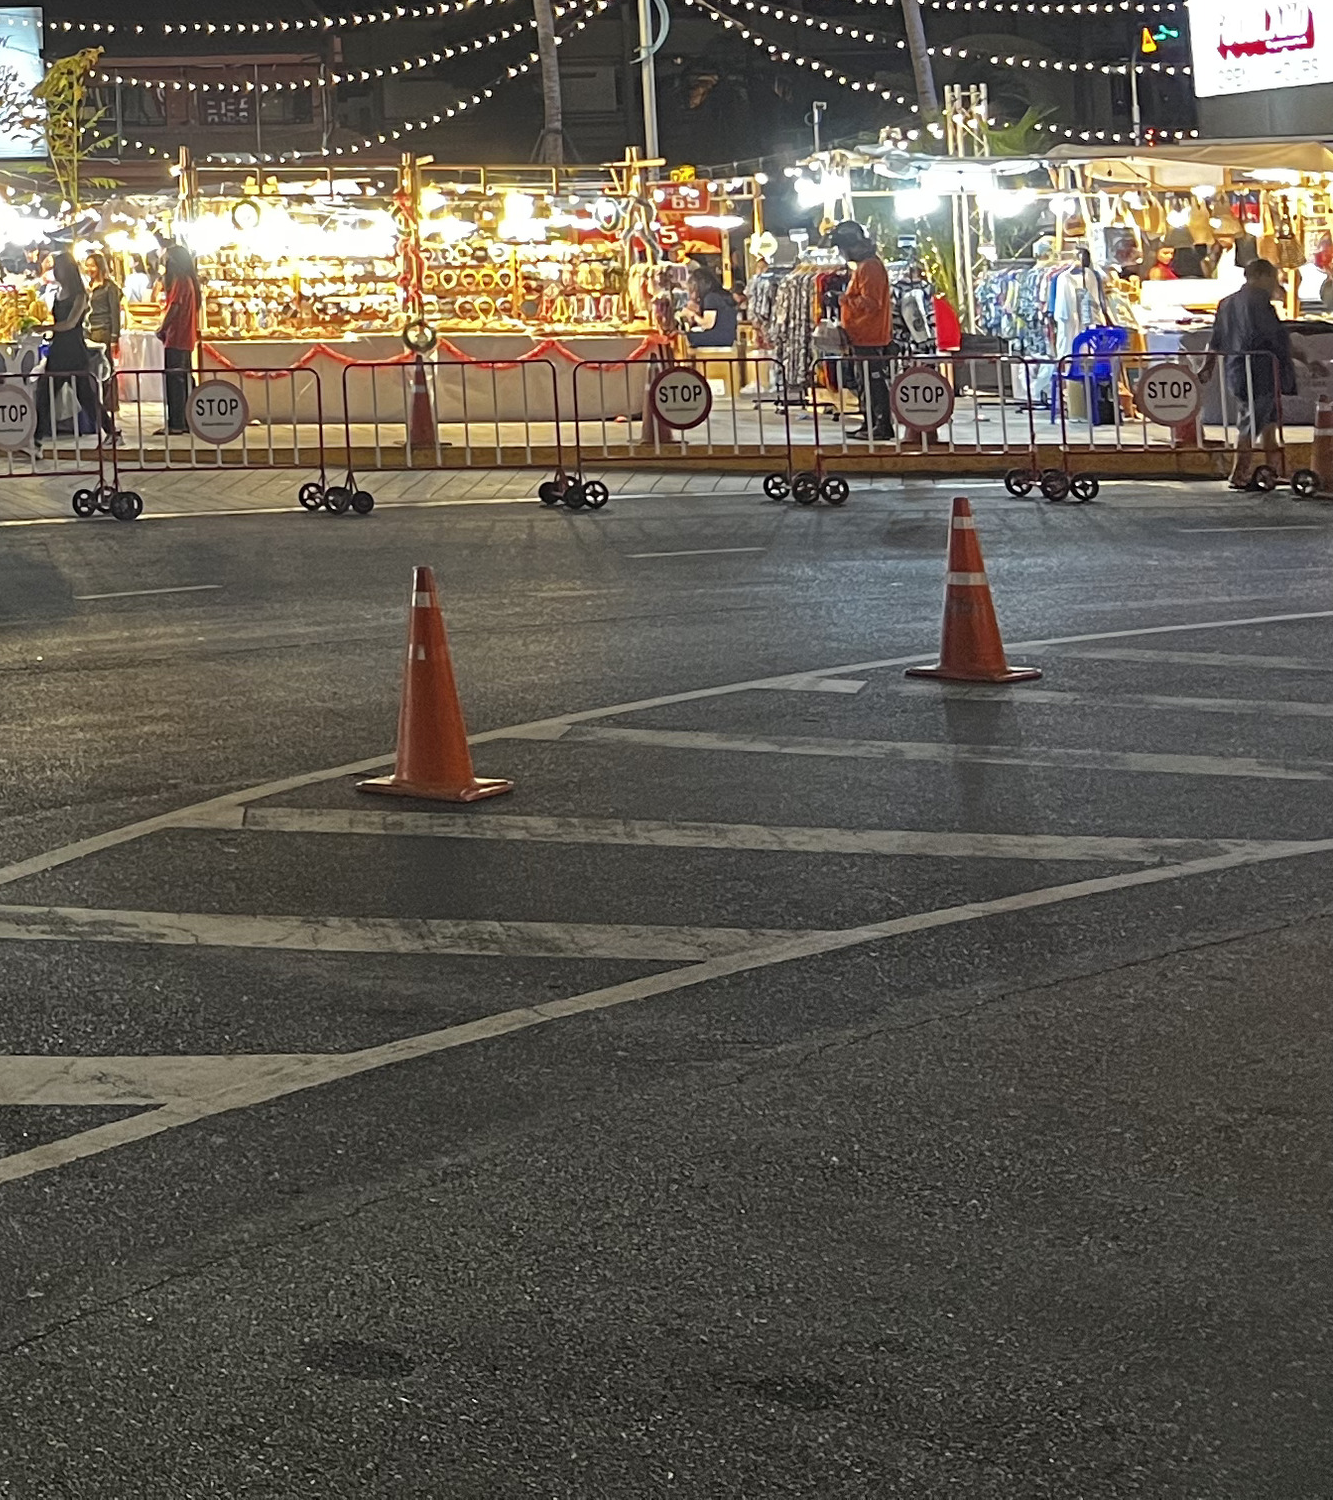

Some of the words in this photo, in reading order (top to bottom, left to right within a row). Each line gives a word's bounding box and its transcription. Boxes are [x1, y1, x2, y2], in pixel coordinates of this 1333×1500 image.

[659, 385, 702, 403] STOP
[900, 386, 944, 404] STOP
[1148, 381, 1192, 399] STOP
[196, 399, 239, 417] STOP
